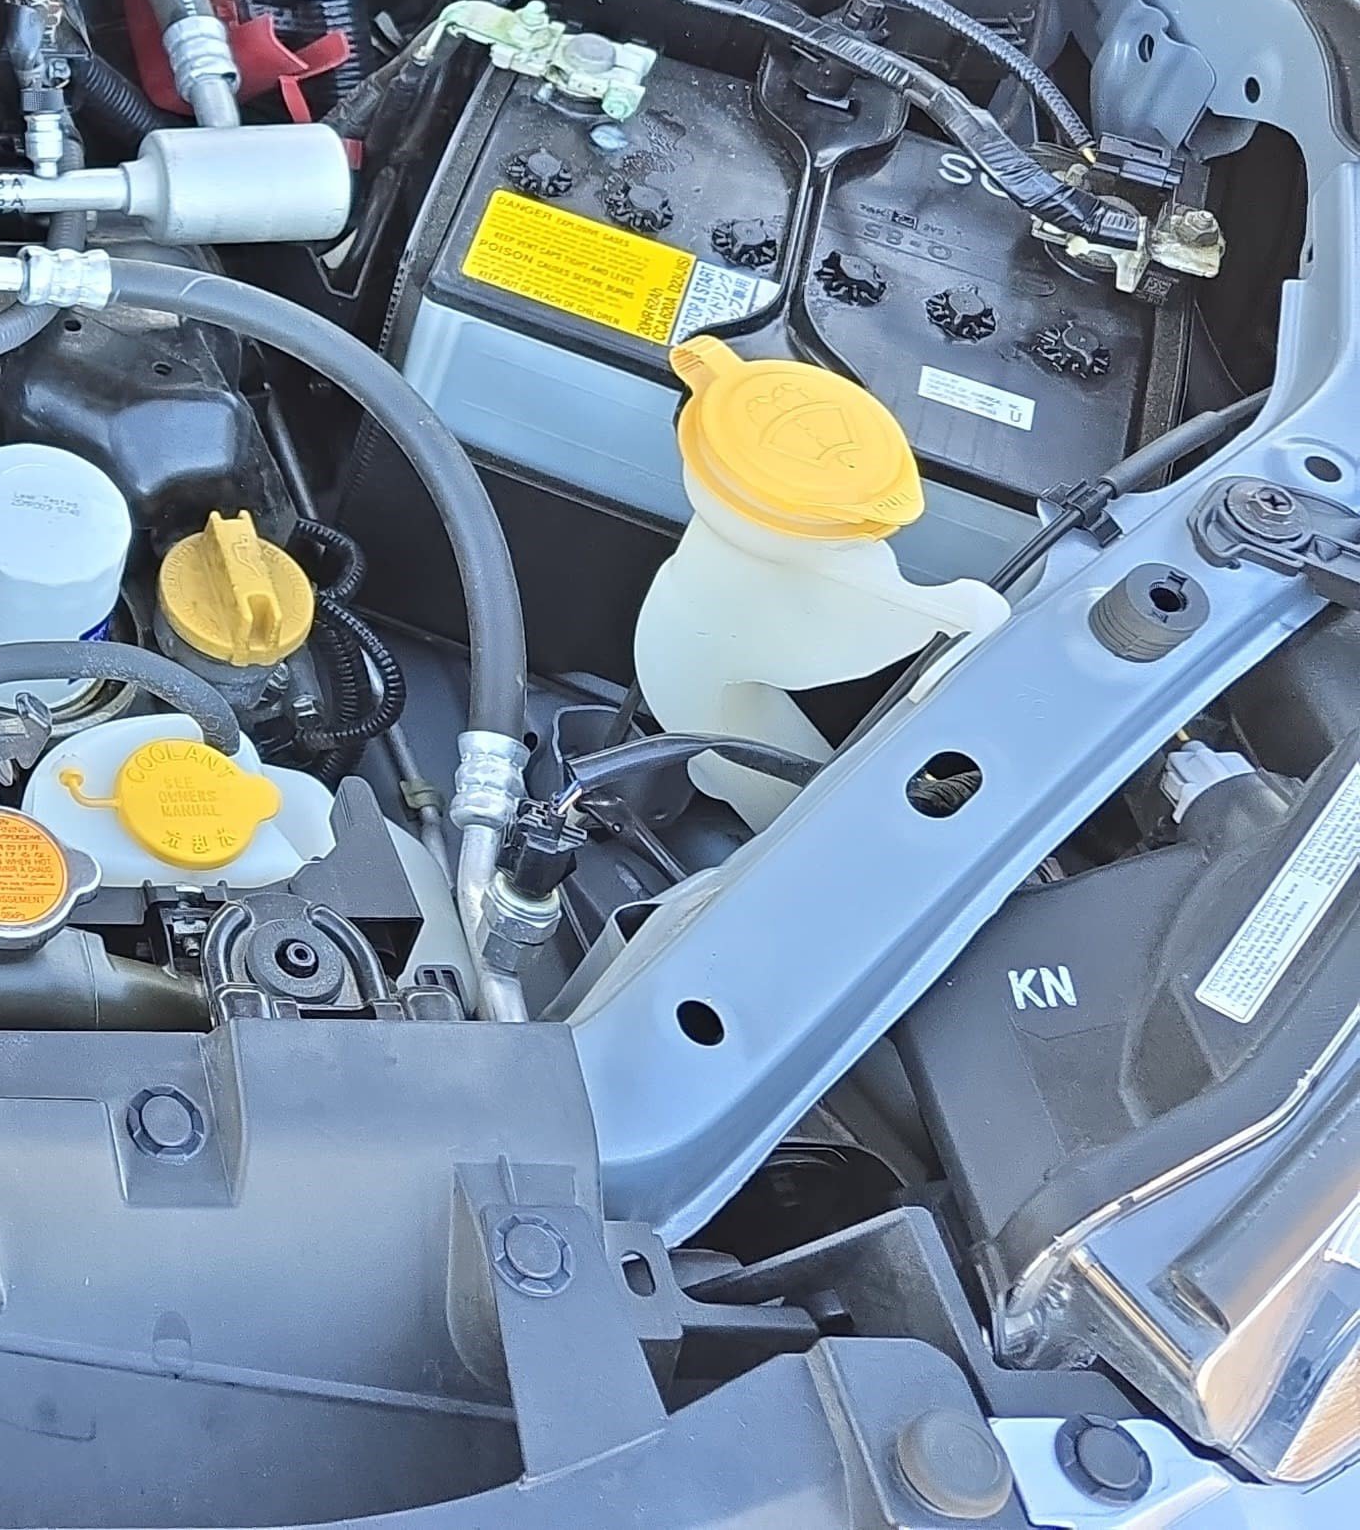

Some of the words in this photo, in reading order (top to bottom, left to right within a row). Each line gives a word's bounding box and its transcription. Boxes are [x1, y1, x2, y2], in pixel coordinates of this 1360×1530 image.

[496, 195, 552, 221] DANGER
[477, 238, 533, 264] POISON
[693, 265, 716, 295] START
[691, 294, 705, 303] &
[575, 303, 620, 325] CHILDREN
[682, 301, 704, 328] STOP
[651, 318, 670, 341] CCA
[871, 491, 917, 517] PULL
[126, 743, 235, 783] COOLANT
[164, 776, 194, 789] SEE
[161, 805, 222, 817] MANUAL
[1007, 966, 1078, 1010] KN
